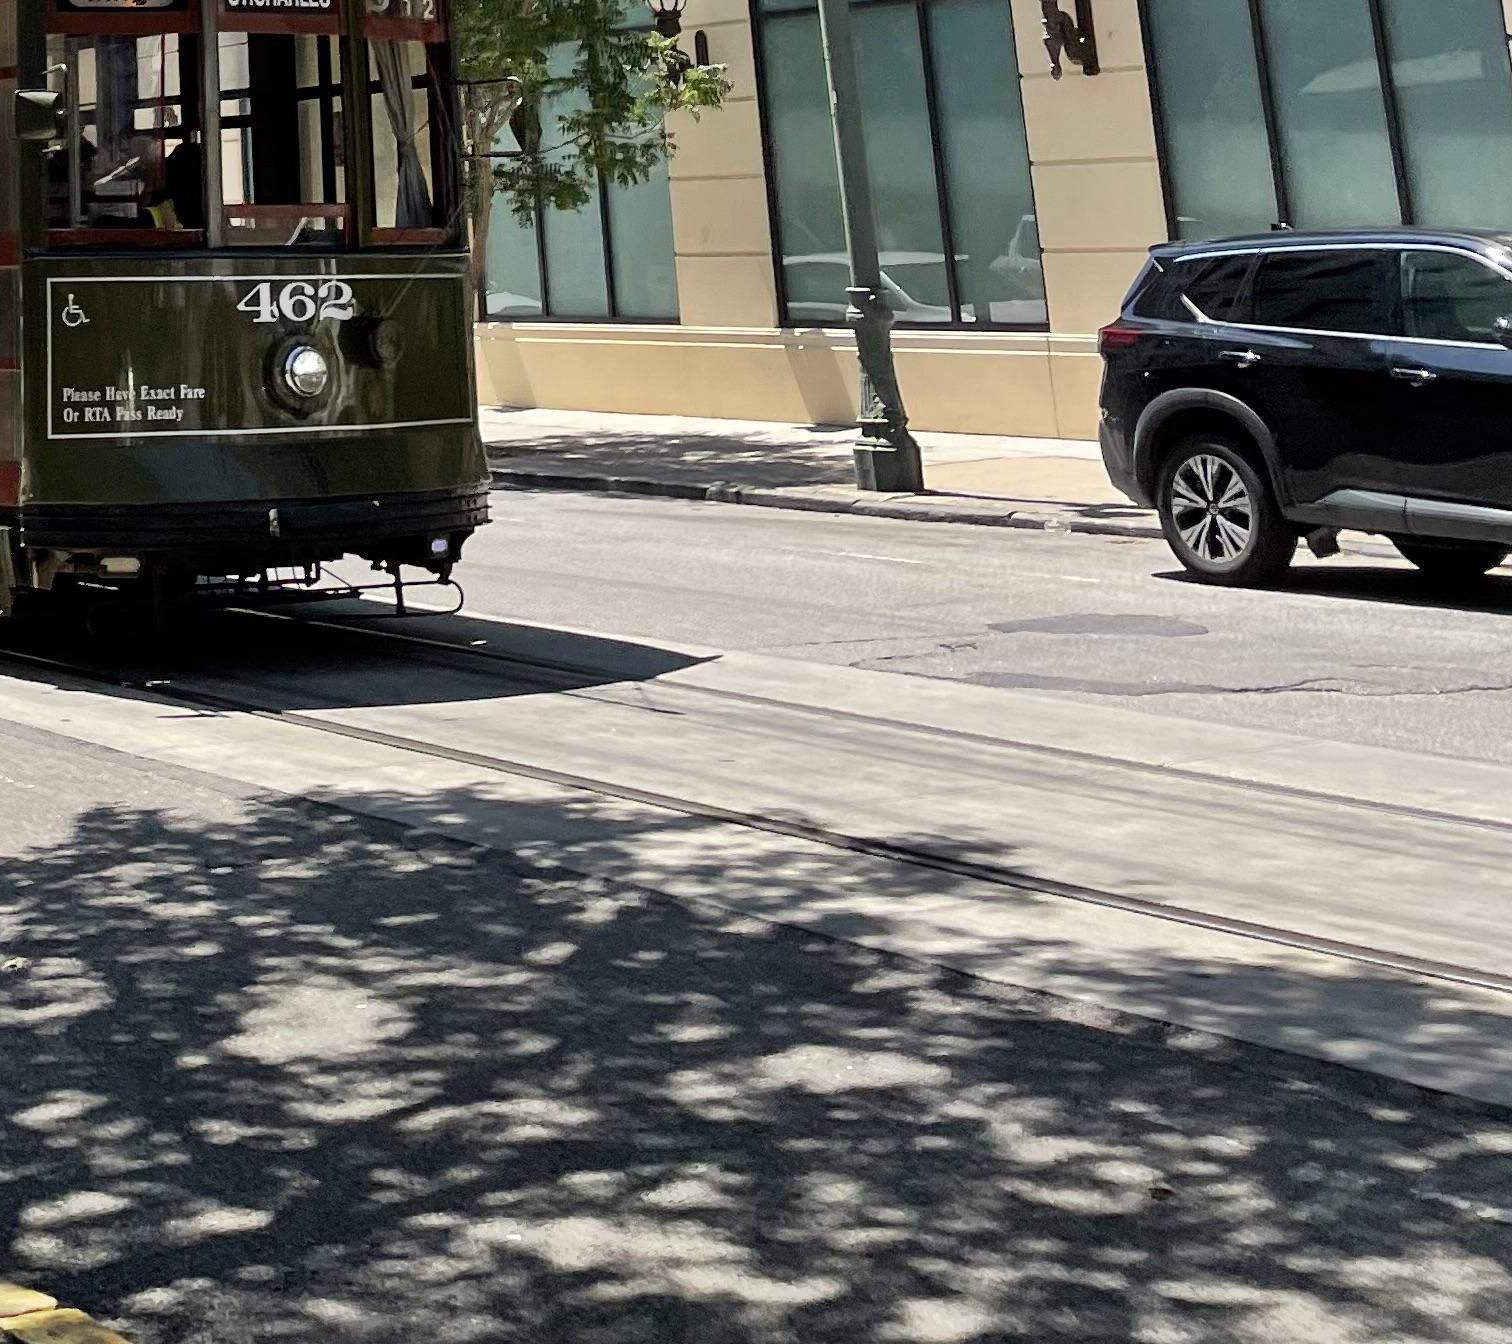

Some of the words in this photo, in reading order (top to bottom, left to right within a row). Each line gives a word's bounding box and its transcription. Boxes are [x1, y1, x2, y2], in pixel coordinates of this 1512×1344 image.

[236, 281, 354, 323] 462
[62, 387, 102, 402] Please
[105, 386, 136, 401] Have
[140, 385, 176, 400] Exact
[180, 384, 206, 399] Fare
[63, 408, 80, 422] Or
[84, 407, 112, 422] RTA
[115, 406, 143, 421] Pass
[147, 405, 184, 422] Ready
